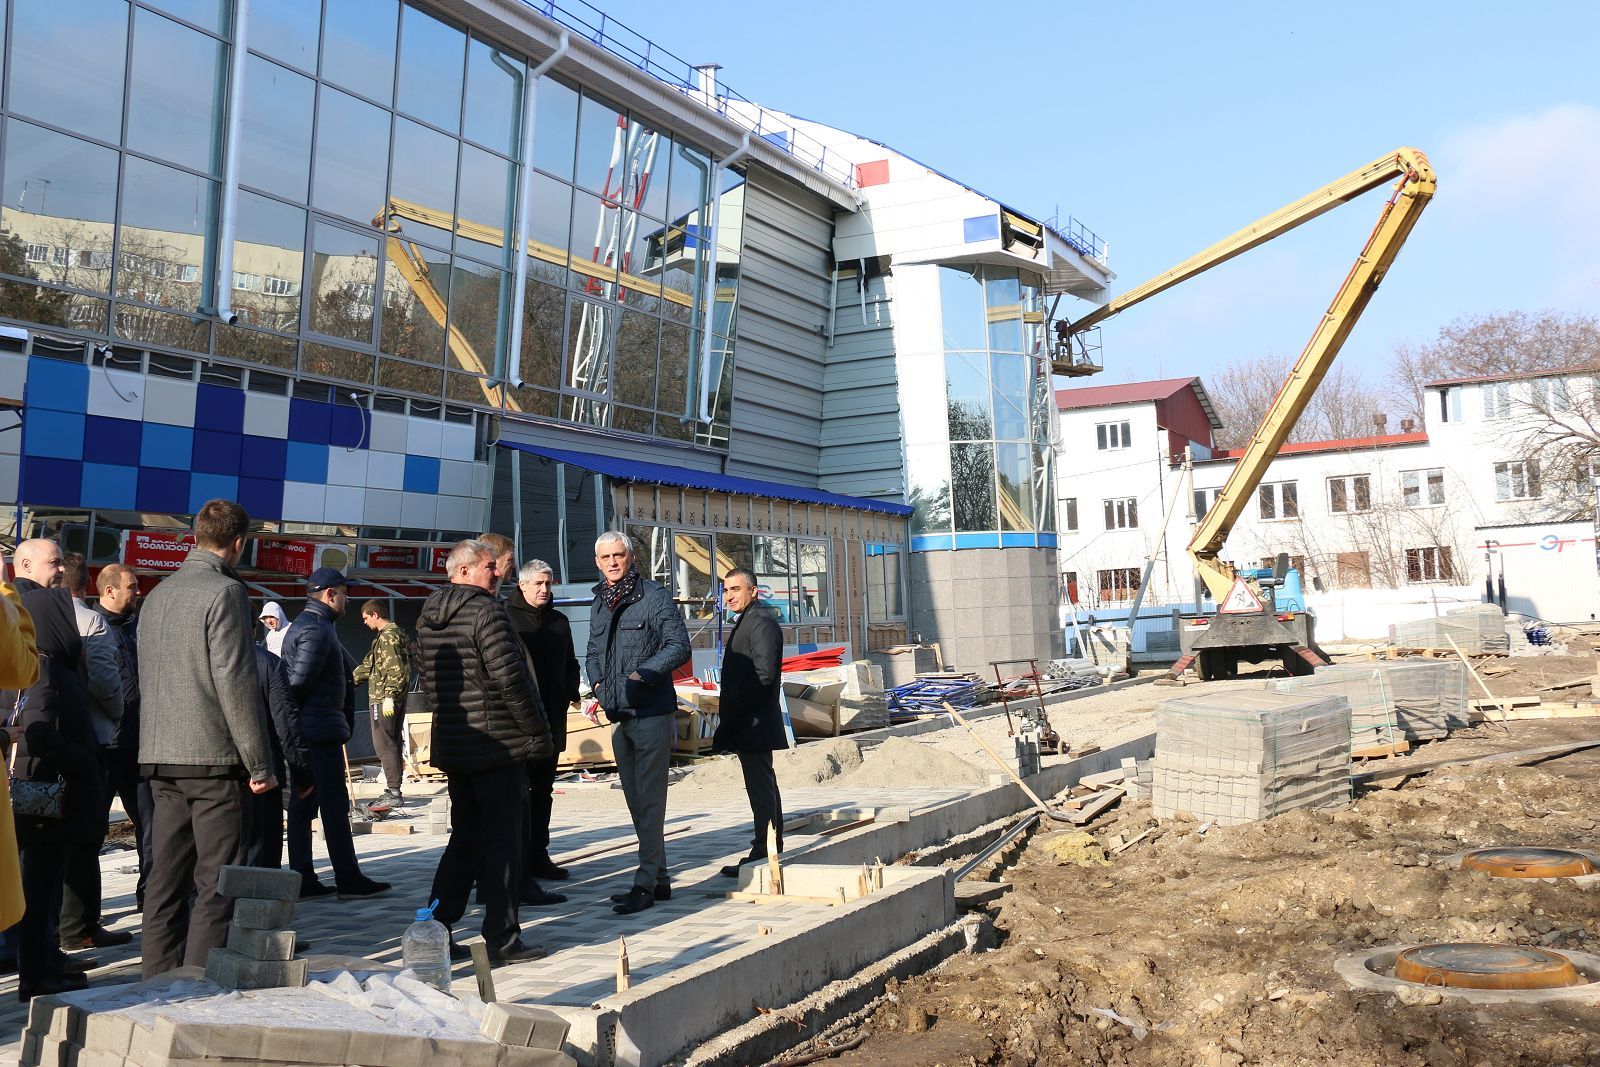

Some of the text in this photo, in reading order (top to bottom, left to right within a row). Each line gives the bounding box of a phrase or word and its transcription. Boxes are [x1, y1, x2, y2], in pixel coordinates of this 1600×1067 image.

[138, 542, 189, 551] ROCKWOOL
[271, 541, 307, 553] ROCKWOOL
[136, 559, 182, 568] OCKWOOL
